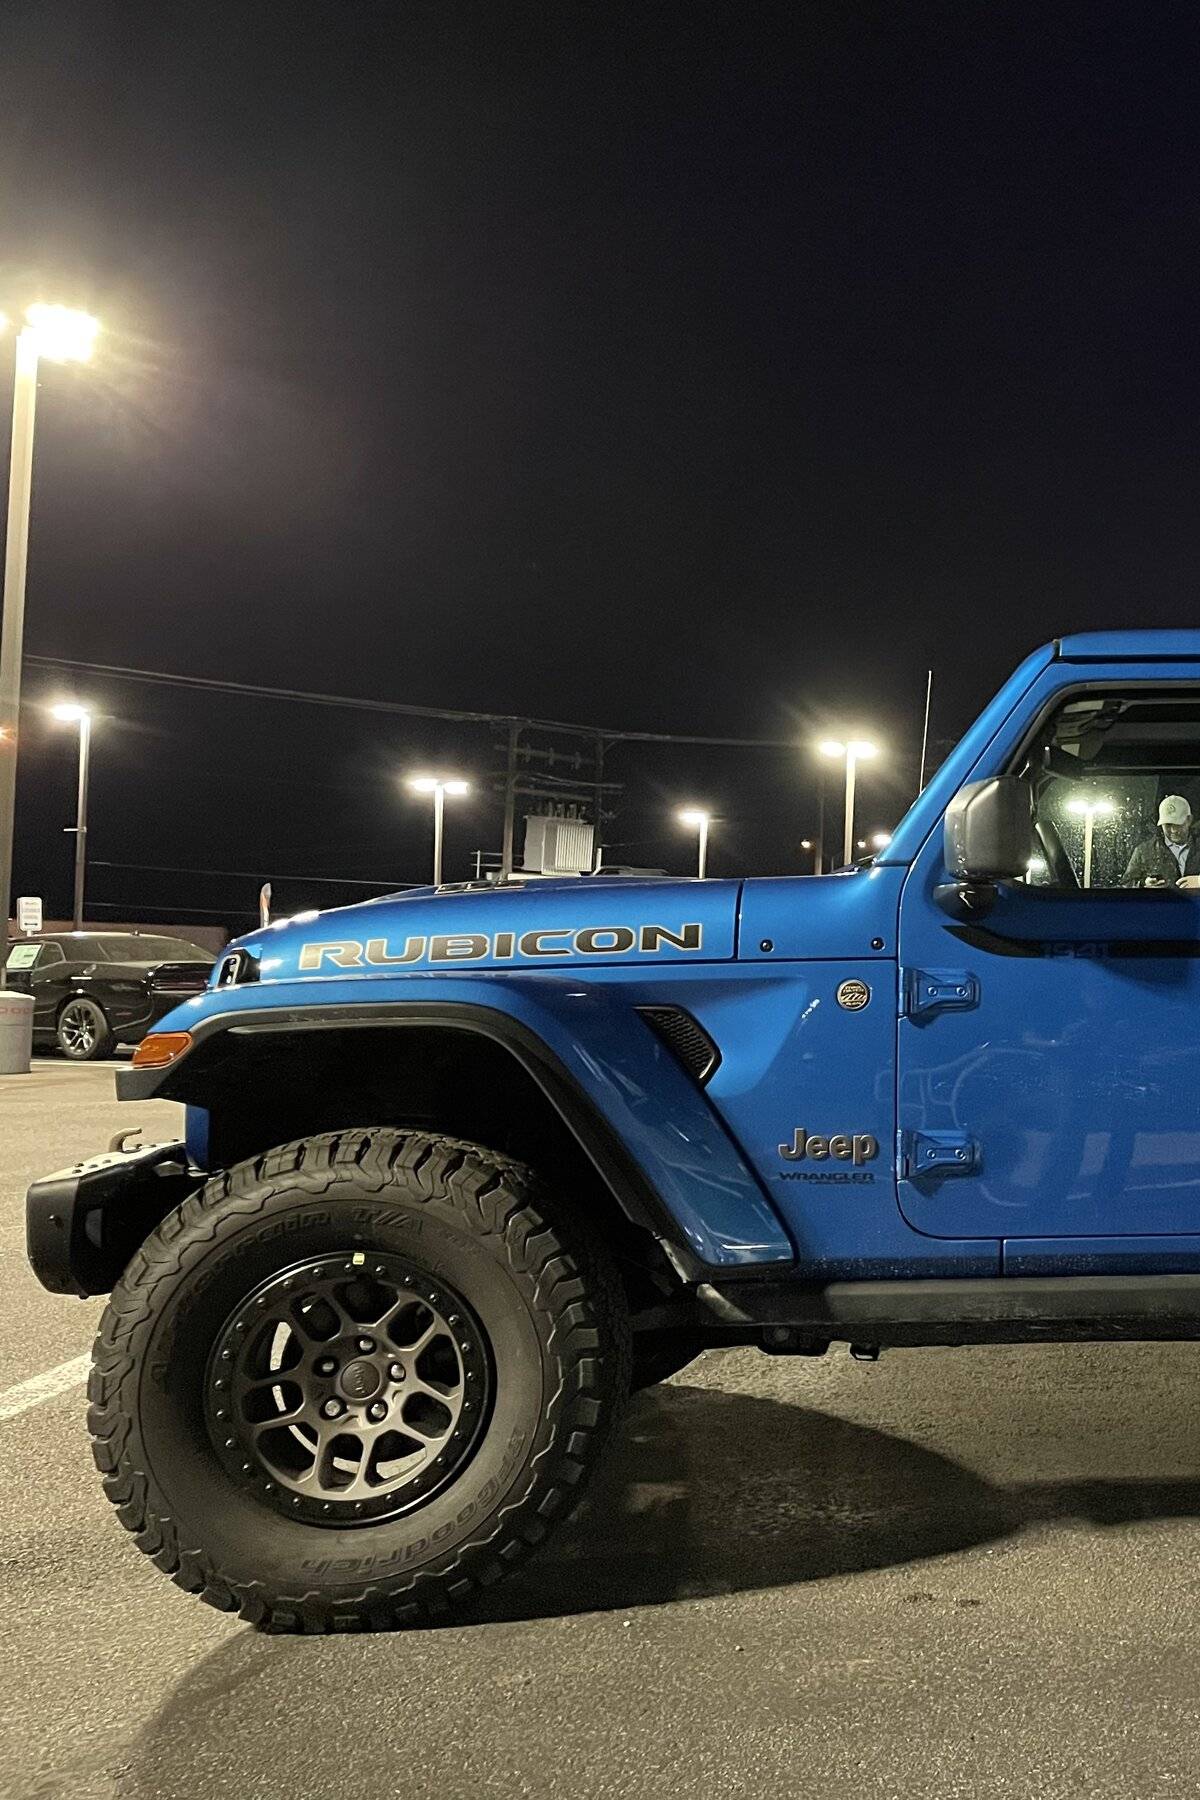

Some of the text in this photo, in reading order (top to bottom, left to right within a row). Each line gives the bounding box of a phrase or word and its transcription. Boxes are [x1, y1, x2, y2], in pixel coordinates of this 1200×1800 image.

[298, 923, 702, 971] RUBICON
[778, 1127, 878, 1167] Jeep
[778, 1172, 875, 1181] WRANGLER
